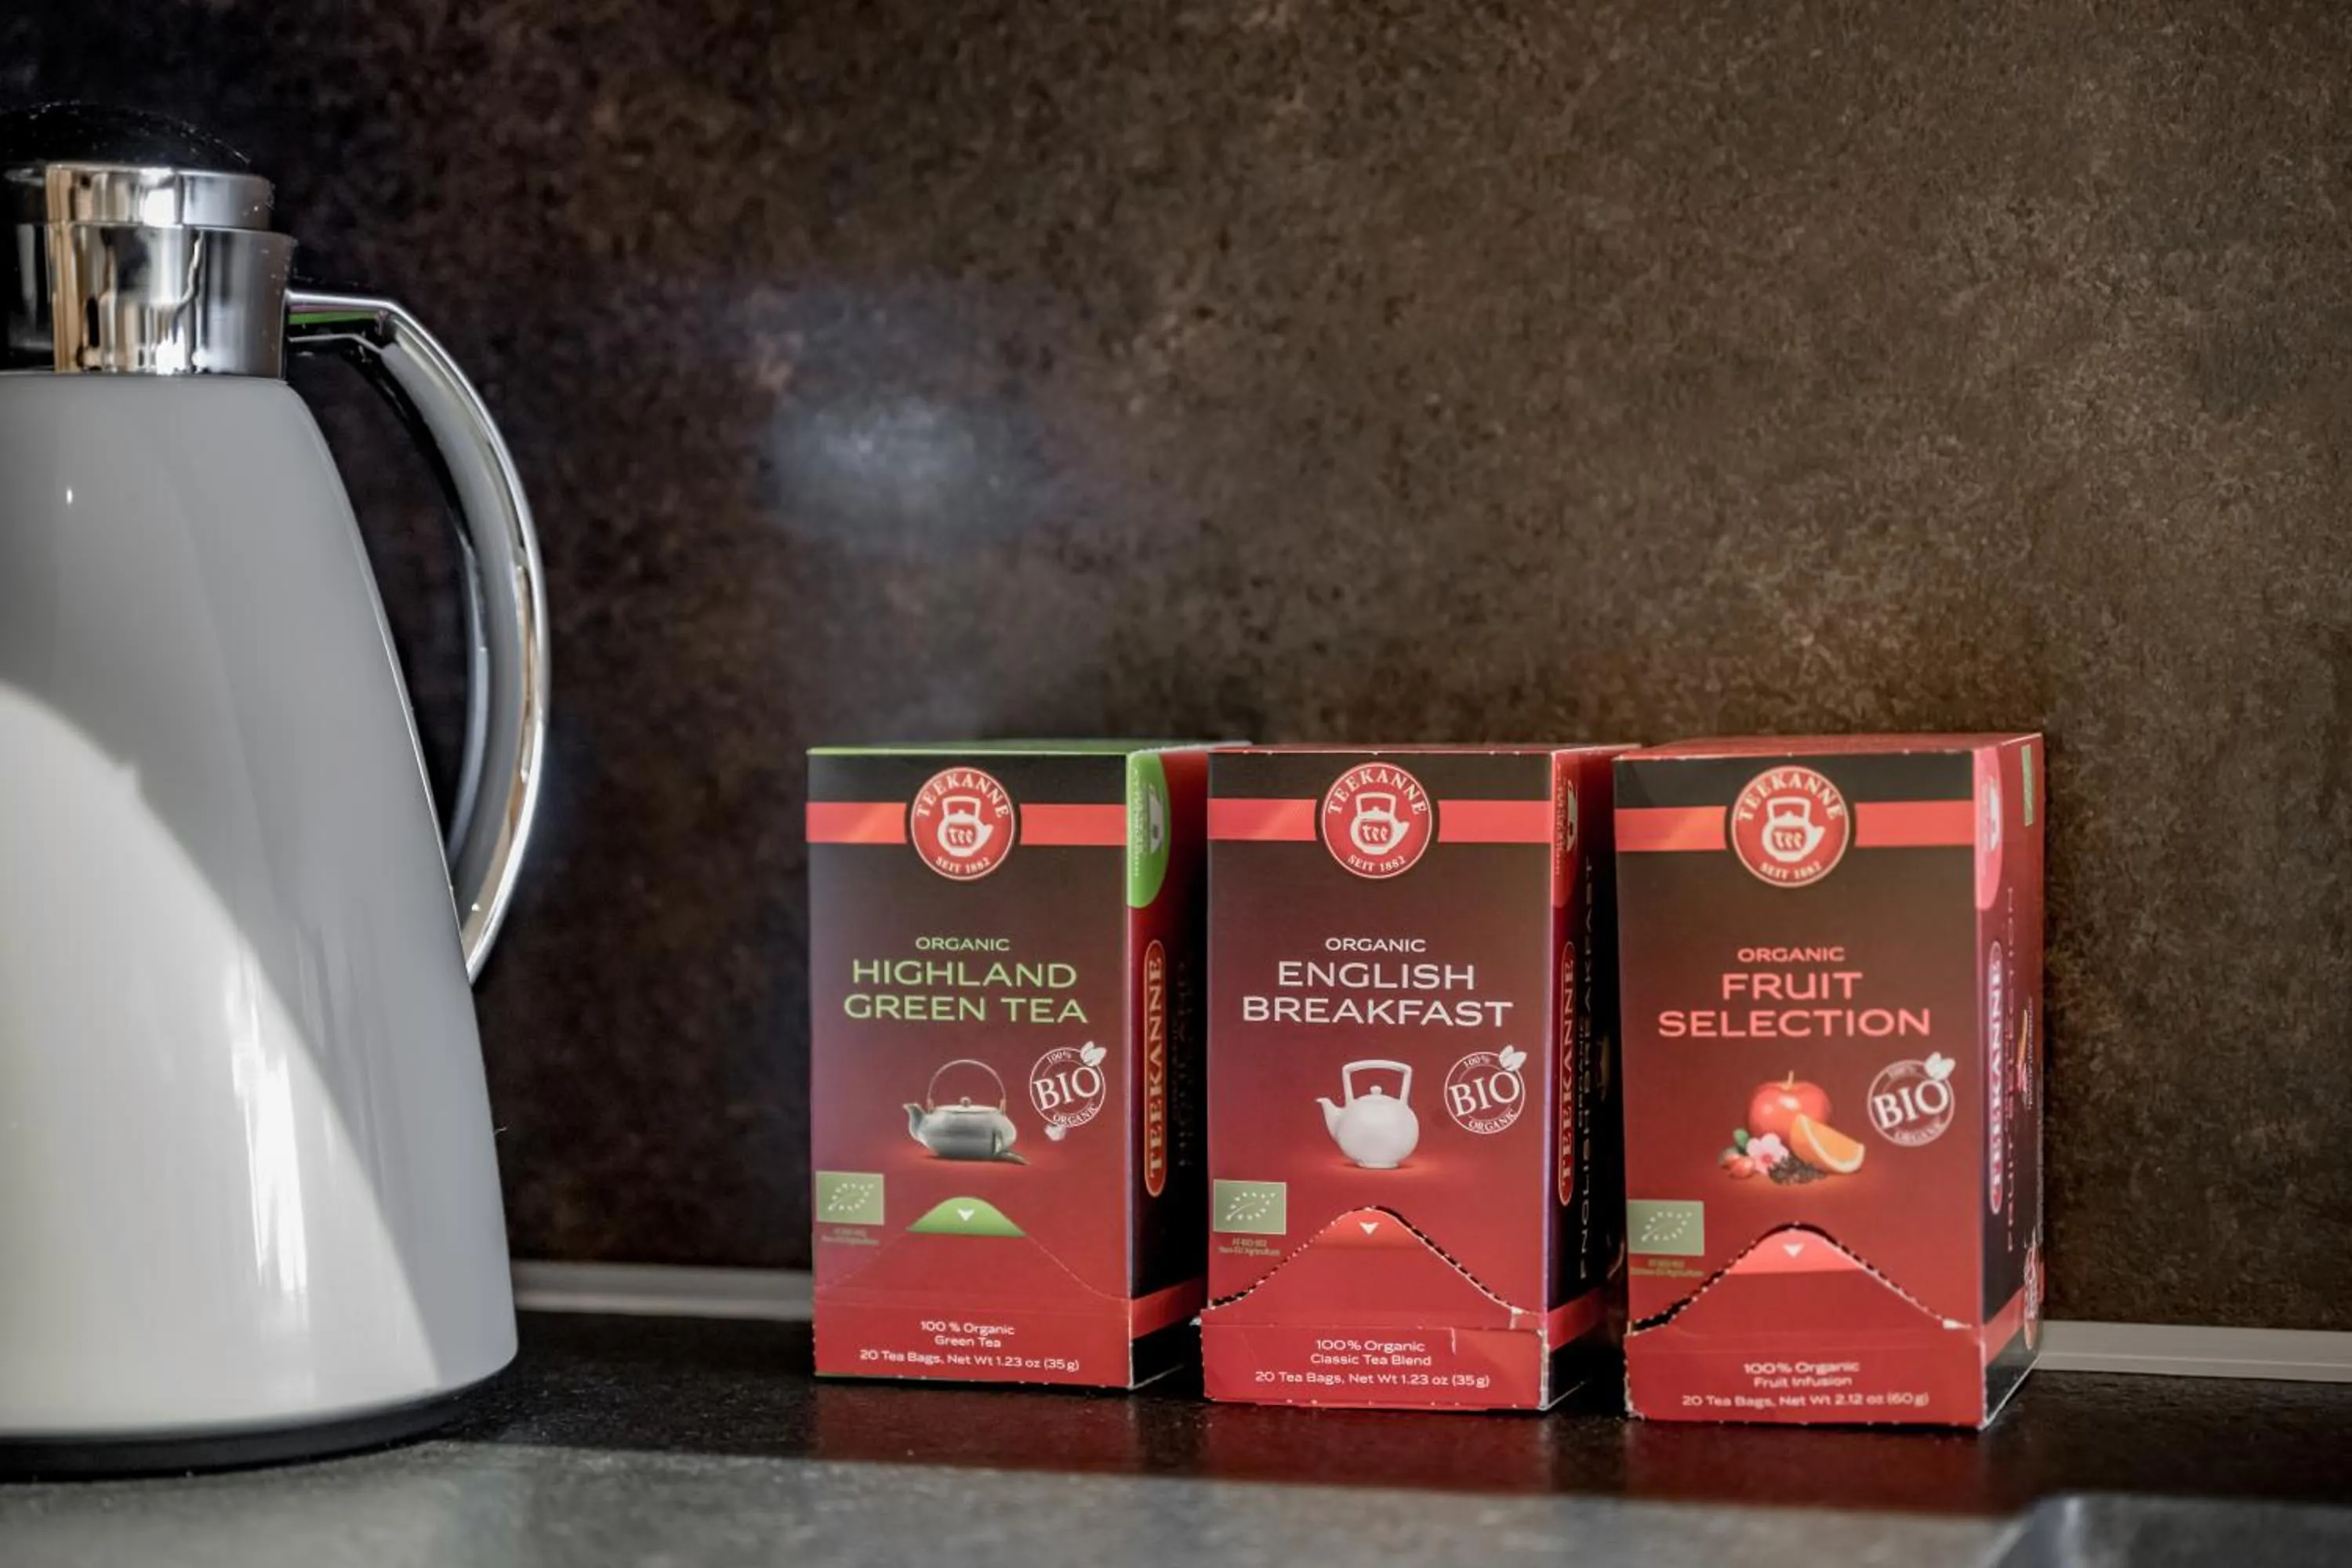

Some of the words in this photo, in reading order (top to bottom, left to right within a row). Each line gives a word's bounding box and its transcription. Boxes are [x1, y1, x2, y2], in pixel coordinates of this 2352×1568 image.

[916, 772, 1009, 818] TEEKANNE
[1328, 768, 1427, 815] TEEKANNE
[1737, 773, 1845, 820] TEEKANNE
[936, 855, 962, 873] SEIT
[1348, 855, 1375, 871] SEIT
[1379, 855, 1406, 872] 1882
[915, 936, 1011, 951] ORGANIC
[1325, 938, 1426, 953] ORGANIC
[1737, 946, 1845, 962] ORGANIC
[852, 958, 1077, 988] HIGHLAND
[1278, 960, 1474, 990] ENGLISH
[1722, 971, 1864, 1000] FRUIT
[844, 993, 985, 1022] GREEN
[1000, 996, 1089, 1023] TEA
[1243, 996, 1514, 1027] BREAKFAST
[1658, 1008, 1930, 1037] SELECTION
[1149, 957, 1162, 1177] TEEKANNE
[1561, 958, 1574, 1187] TEEKANNE
[1033, 1066, 1100, 1111] BIO
[1448, 1072, 1520, 1117] BIO
[1873, 1080, 1949, 1130] BIO
[935, 1335, 975, 1346] Green
[978, 1337, 1001, 1348] Tea
[964, 1323, 1015, 1337] Organic
[860, 1349, 878, 1360] 20
[881, 1350, 904, 1362] Tea
[947, 1354, 971, 1364] Net
[974, 1355, 993, 1366] Wt
[996, 1356, 1022, 1367] 1.23
[1025, 1359, 1041, 1368] oz
[1364, 1340, 1425, 1354] Organic
[1310, 1353, 1359, 1364] Classic
[1362, 1354, 1388, 1365] Tea
[1392, 1354, 1432, 1366] Blend
[1795, 1361, 1860, 1376] Organic
[1255, 1371, 1275, 1382] 20
[1277, 1371, 1303, 1382] Tea
[1348, 1373, 1374, 1384] Net
[1377, 1374, 1398, 1385] Wt
[1401, 1374, 1428, 1385] 1.23
[1432, 1376, 1449, 1385] oz
[1753, 1376, 1790, 1388] Fruit
[1791, 1376, 1853, 1388] Infusion
[1682, 1395, 1703, 1406] 20
[1706, 1395, 1732, 1406] Tea
[1779, 1395, 1806, 1406] Net
[1809, 1394, 1831, 1406] Wt
[1835, 1392, 1864, 1406] 2.12
[1866, 1394, 1884, 1405] oz
